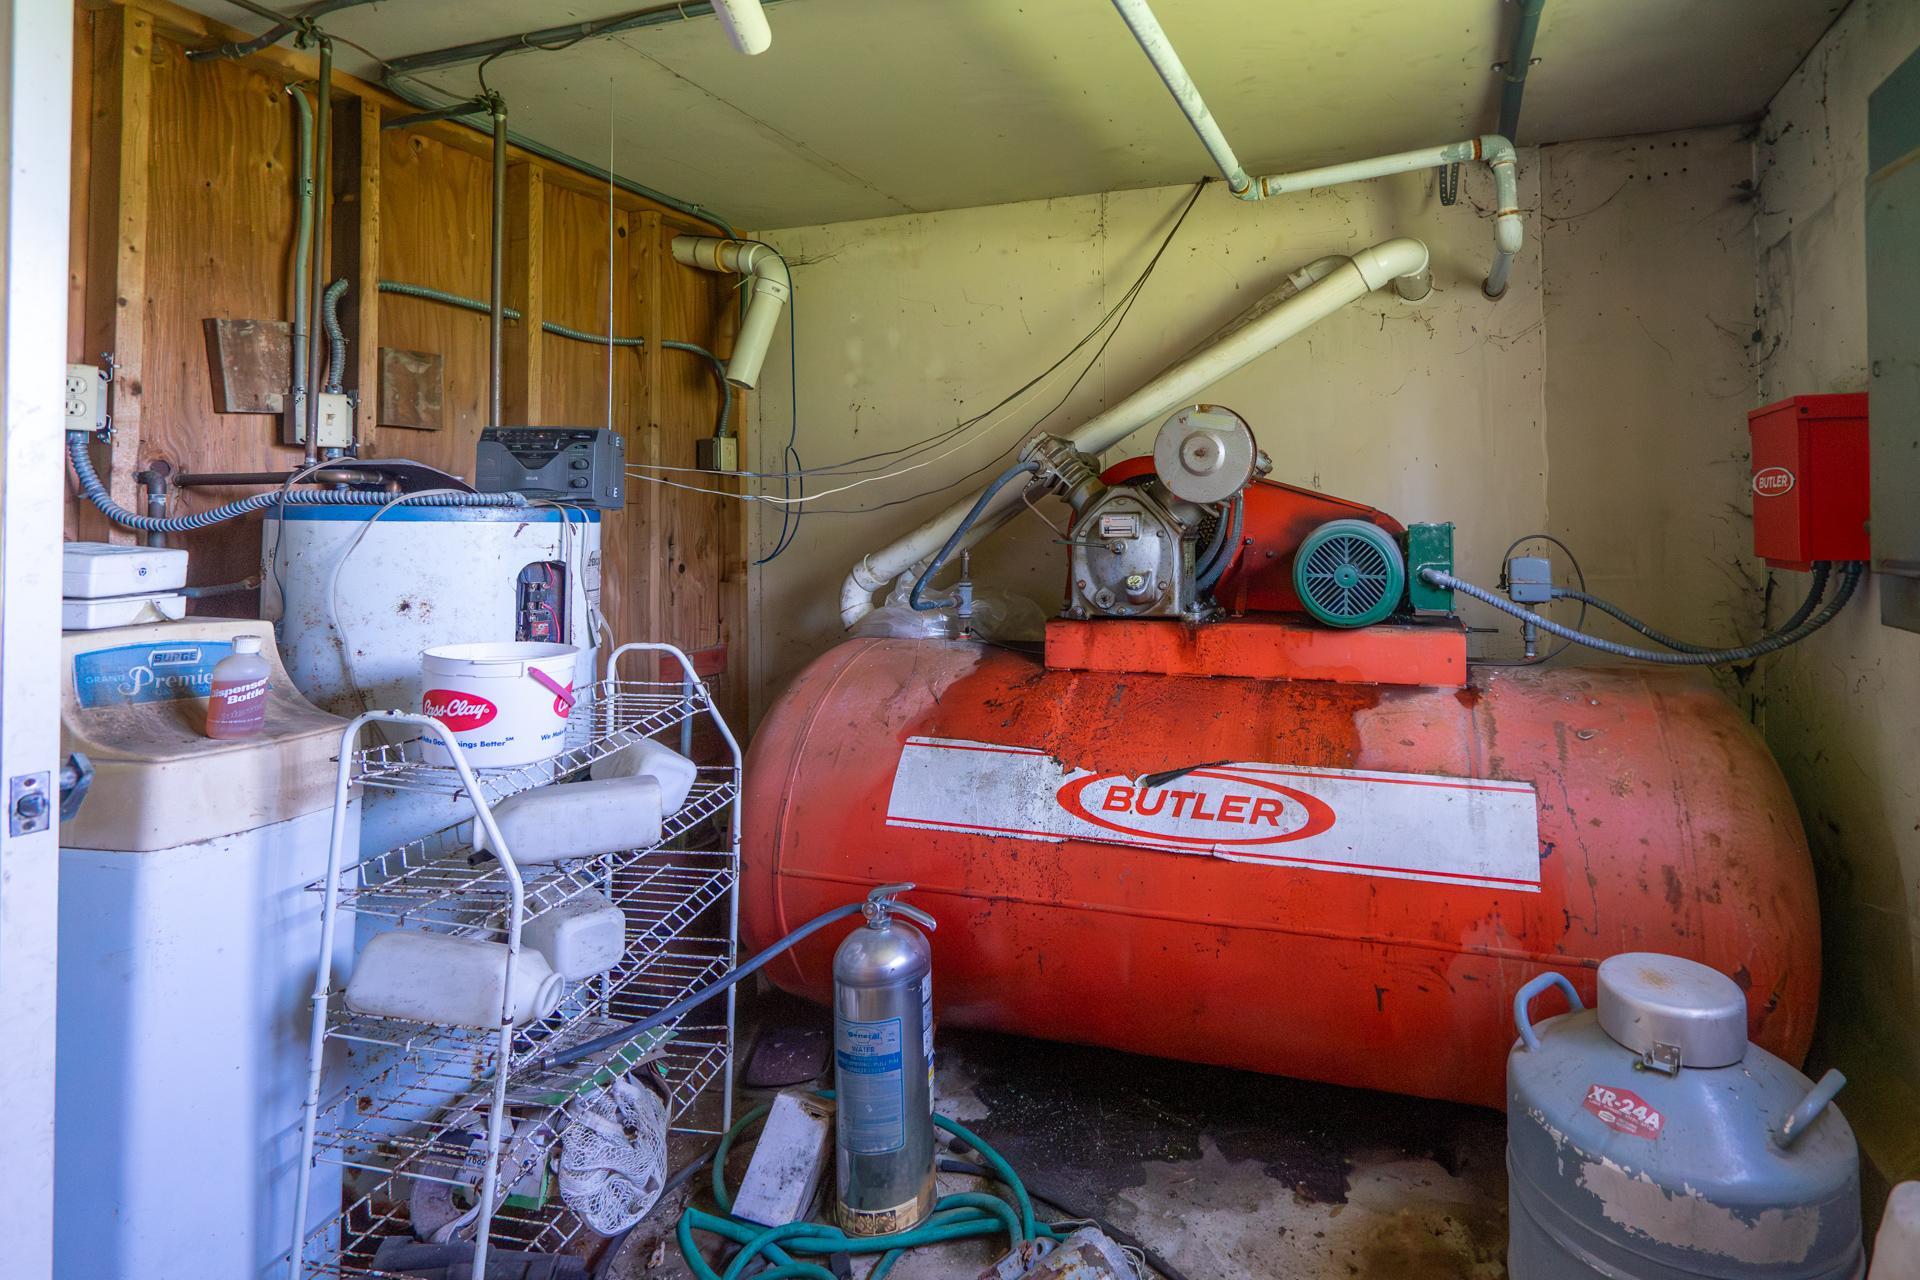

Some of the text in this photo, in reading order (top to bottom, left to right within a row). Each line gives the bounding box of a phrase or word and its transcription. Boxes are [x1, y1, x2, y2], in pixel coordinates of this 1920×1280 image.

[1759, 474, 1788, 488] BUTLER
[153, 652, 198, 663] SURGE
[117, 665, 214, 696] Premie
[227, 688, 265, 705] Bottle
[480, 740, 506, 748] Better
[1102, 785, 1284, 827] BUTLER
[1587, 1085, 1661, 1130] XR-24A
